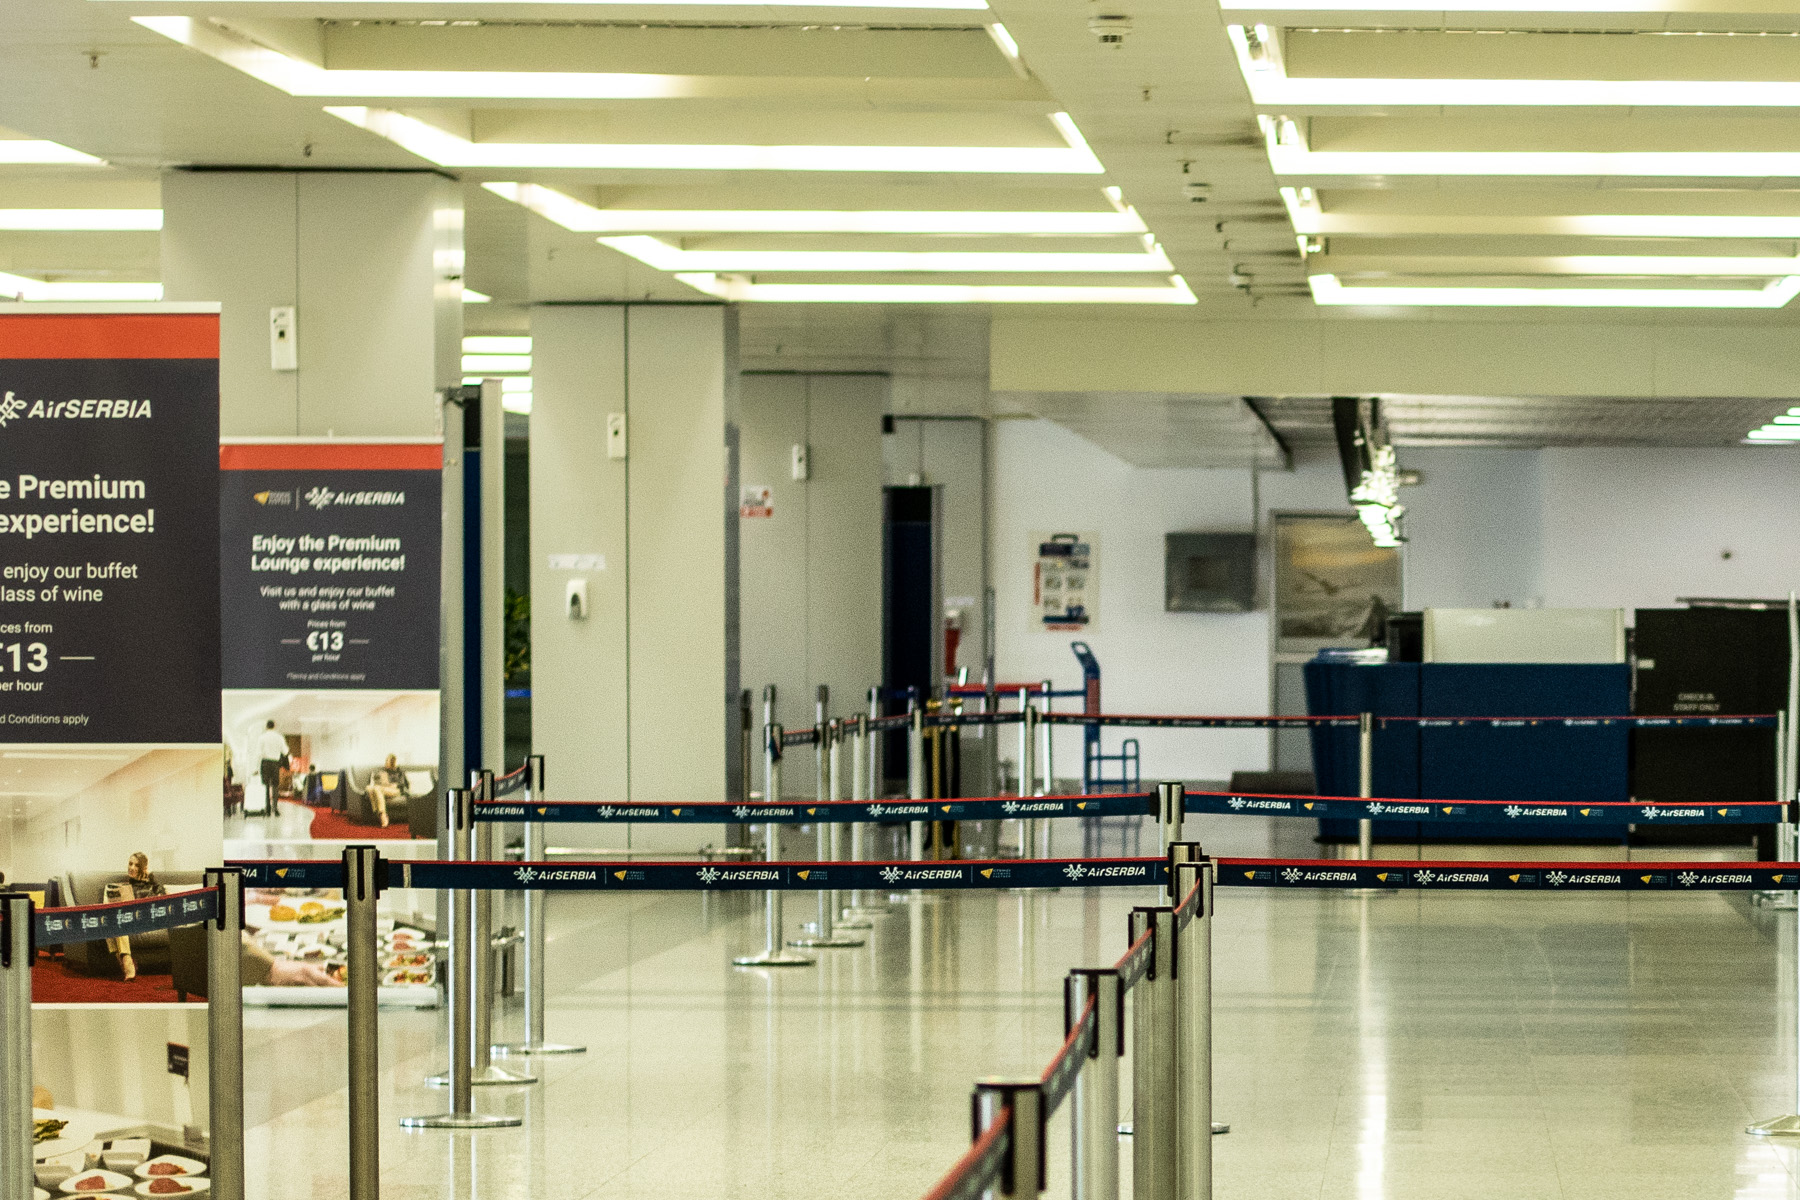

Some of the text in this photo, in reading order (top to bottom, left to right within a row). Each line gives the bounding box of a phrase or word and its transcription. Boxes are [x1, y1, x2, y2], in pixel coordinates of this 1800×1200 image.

[28, 399, 152, 419] AirSERBIA
[18, 473, 146, 499] Premium
[334, 491, 405, 506] AirSERBIA
[0, 507, 155, 540] experience!
[252, 533, 400, 555] Enjoy the Premium
[251, 554, 405, 574] Lounge experience!
[3, 562, 138, 583] enjoy our buffet
[40, 585, 59, 602] of
[63, 586, 104, 602] wine
[260, 585, 395, 598] Visit us and enjoy our buffet
[279, 599, 300, 611] with
[311, 599, 337, 613] glass
[338, 599, 350, 611] of
[351, 600, 376, 611] wine
[24, 621, 53, 634] from
[306, 631, 343, 651] €13
[0, 641, 49, 673] 13
[0, 679, 44, 692] er hour
[8, 713, 61, 725] Conditions
[62, 713, 90, 727] apply
[1018, 803, 1064, 811] AirSERBIA
[1245, 801, 1291, 809] AirSERBIA
[480, 807, 524, 815] AirSERBIA
[749, 808, 794, 816] AirSERBIA
[883, 806, 928, 814] AirSERBIA
[1383, 806, 1429, 814] AirSERBIA
[1521, 808, 1567, 816] AirSERBIA
[1659, 809, 1704, 817] AirSERBIA
[537, 871, 596, 880] AirSERBIA
[719, 871, 779, 880] AirSERBIA
[903, 870, 962, 879] AirSERBIA
[1086, 867, 1145, 876] AirSERBIA
[1302, 872, 1357, 881] AirSERBIA
[1437, 873, 1489, 882] AirSERBIA
[1567, 875, 1621, 883] AirSERBIA
[1698, 875, 1752, 883] AirSERBIA
